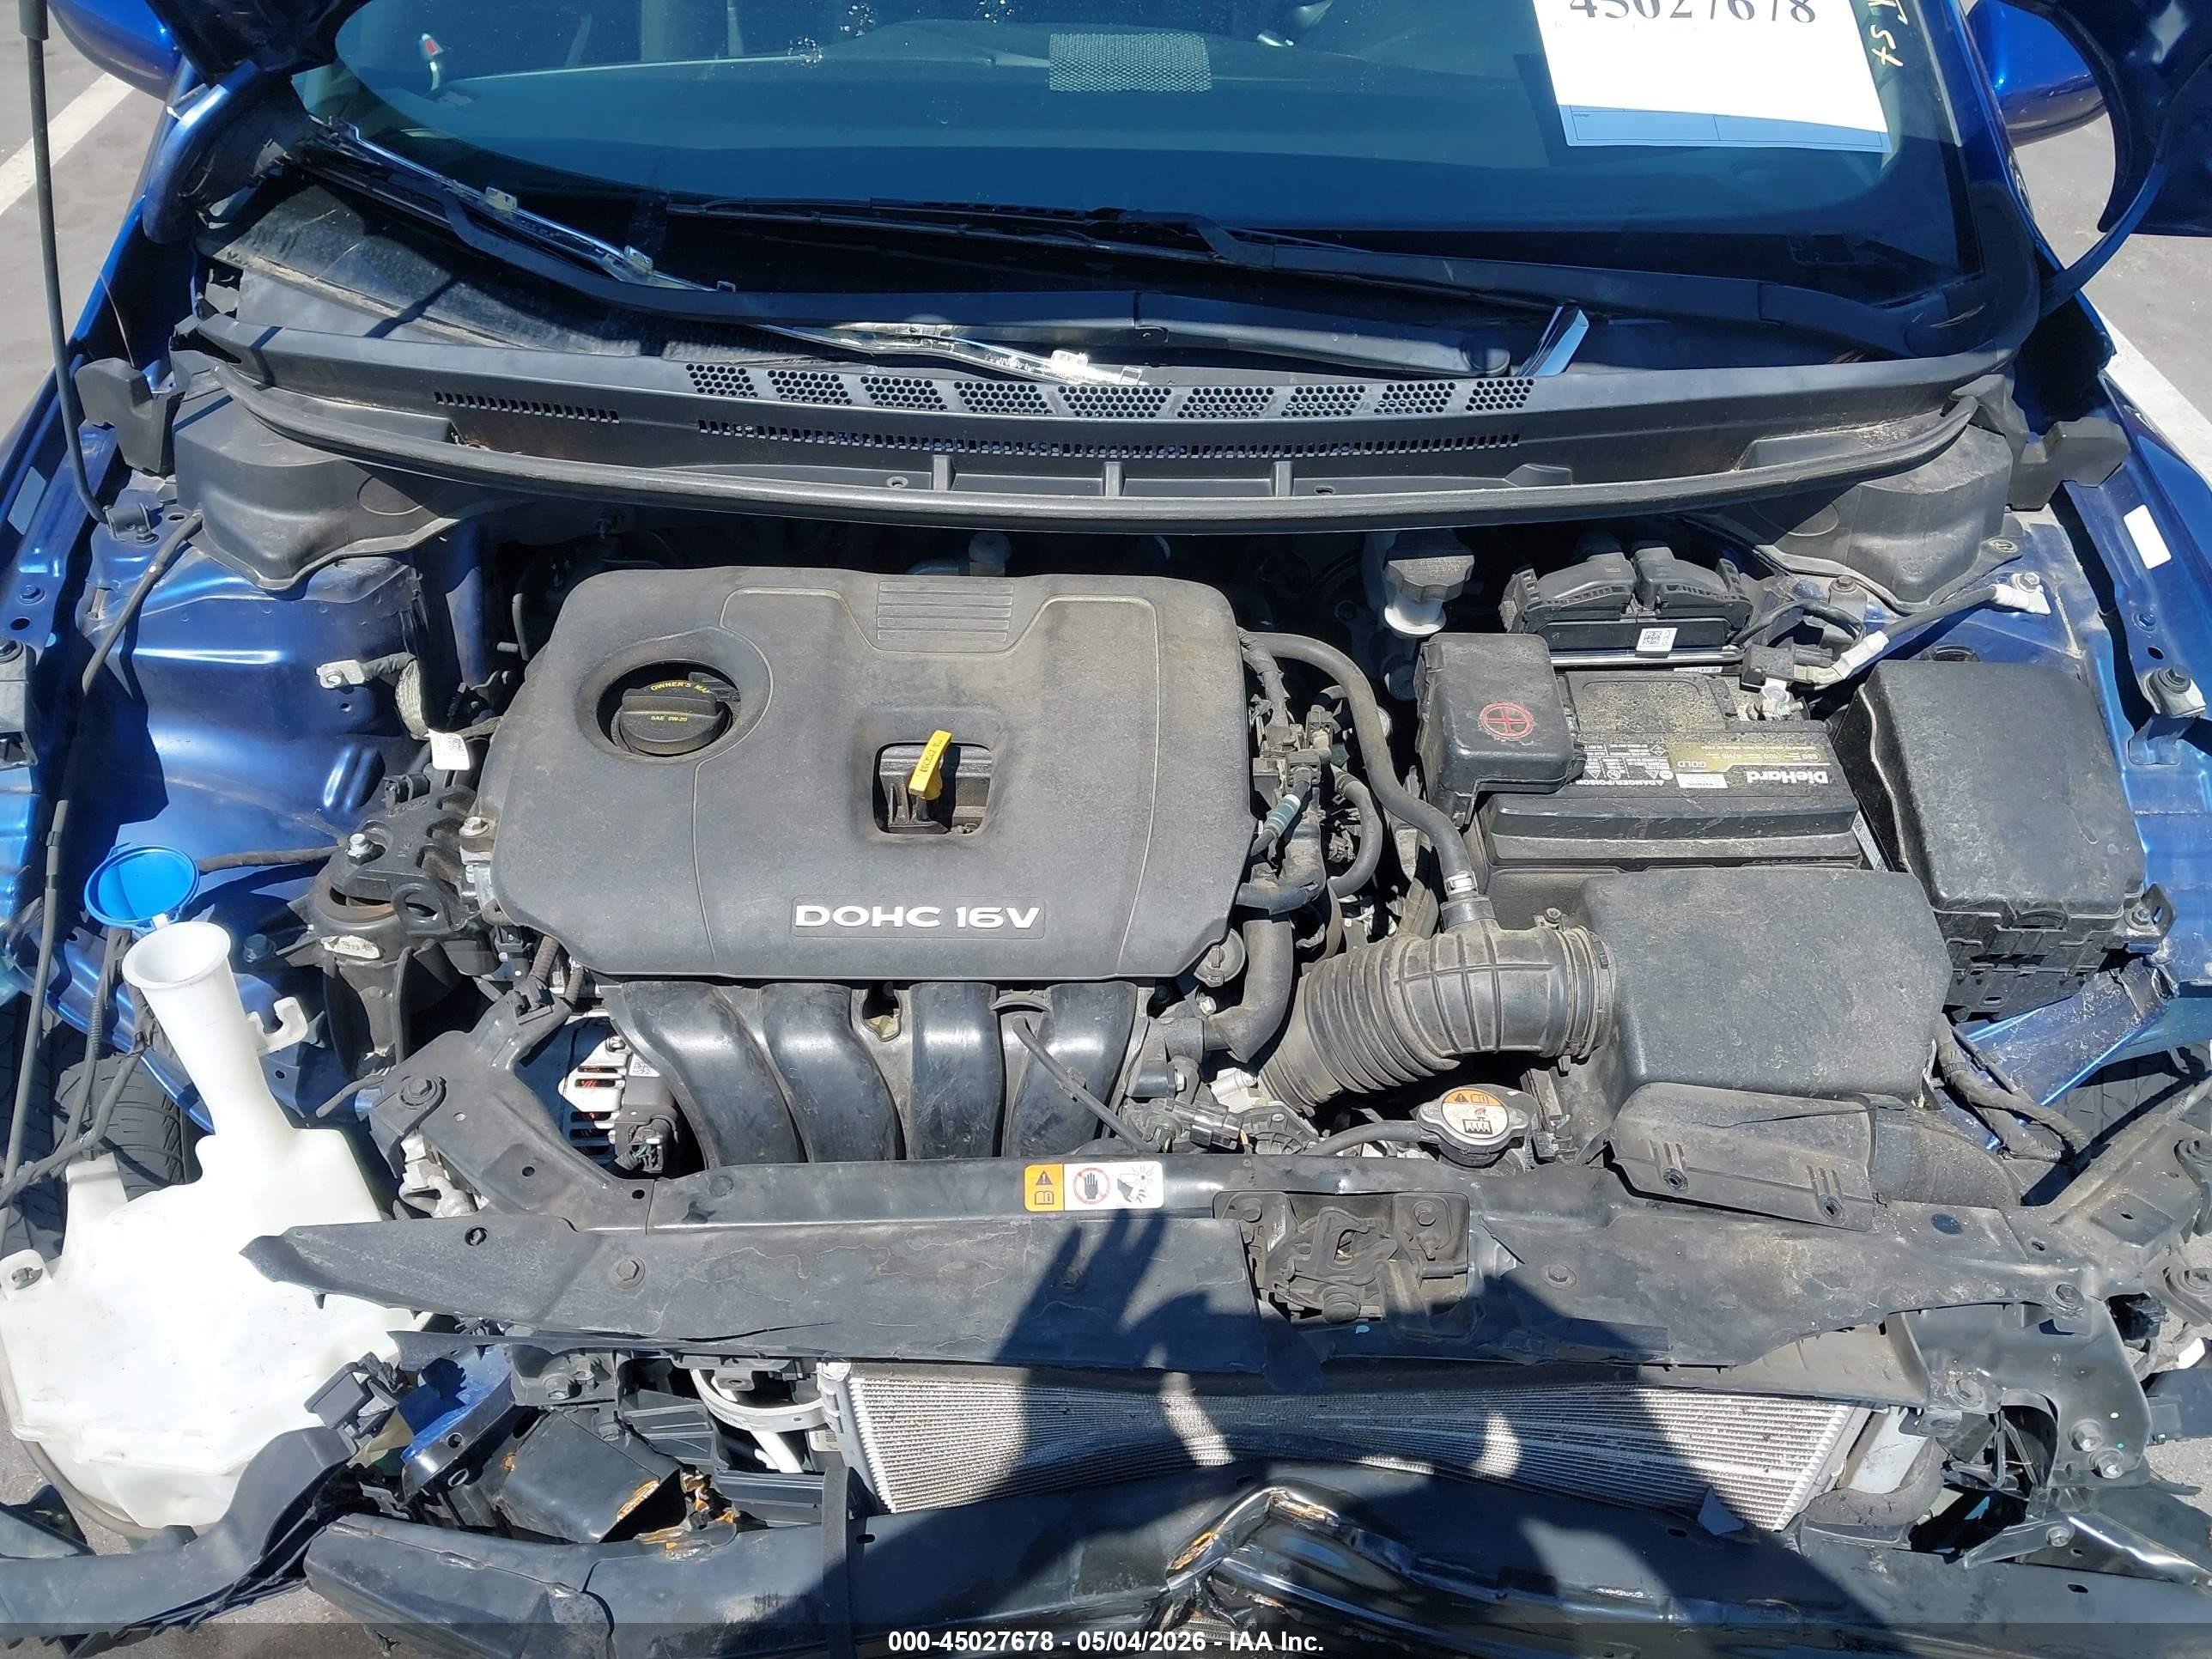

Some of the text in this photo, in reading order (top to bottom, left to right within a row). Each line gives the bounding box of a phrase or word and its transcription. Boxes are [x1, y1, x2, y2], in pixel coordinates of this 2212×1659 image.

[651, 681, 692, 690] OWNER'S
[1747, 771, 1829, 784] DieHard
[795, 905, 1041, 929] DOHC 16V
